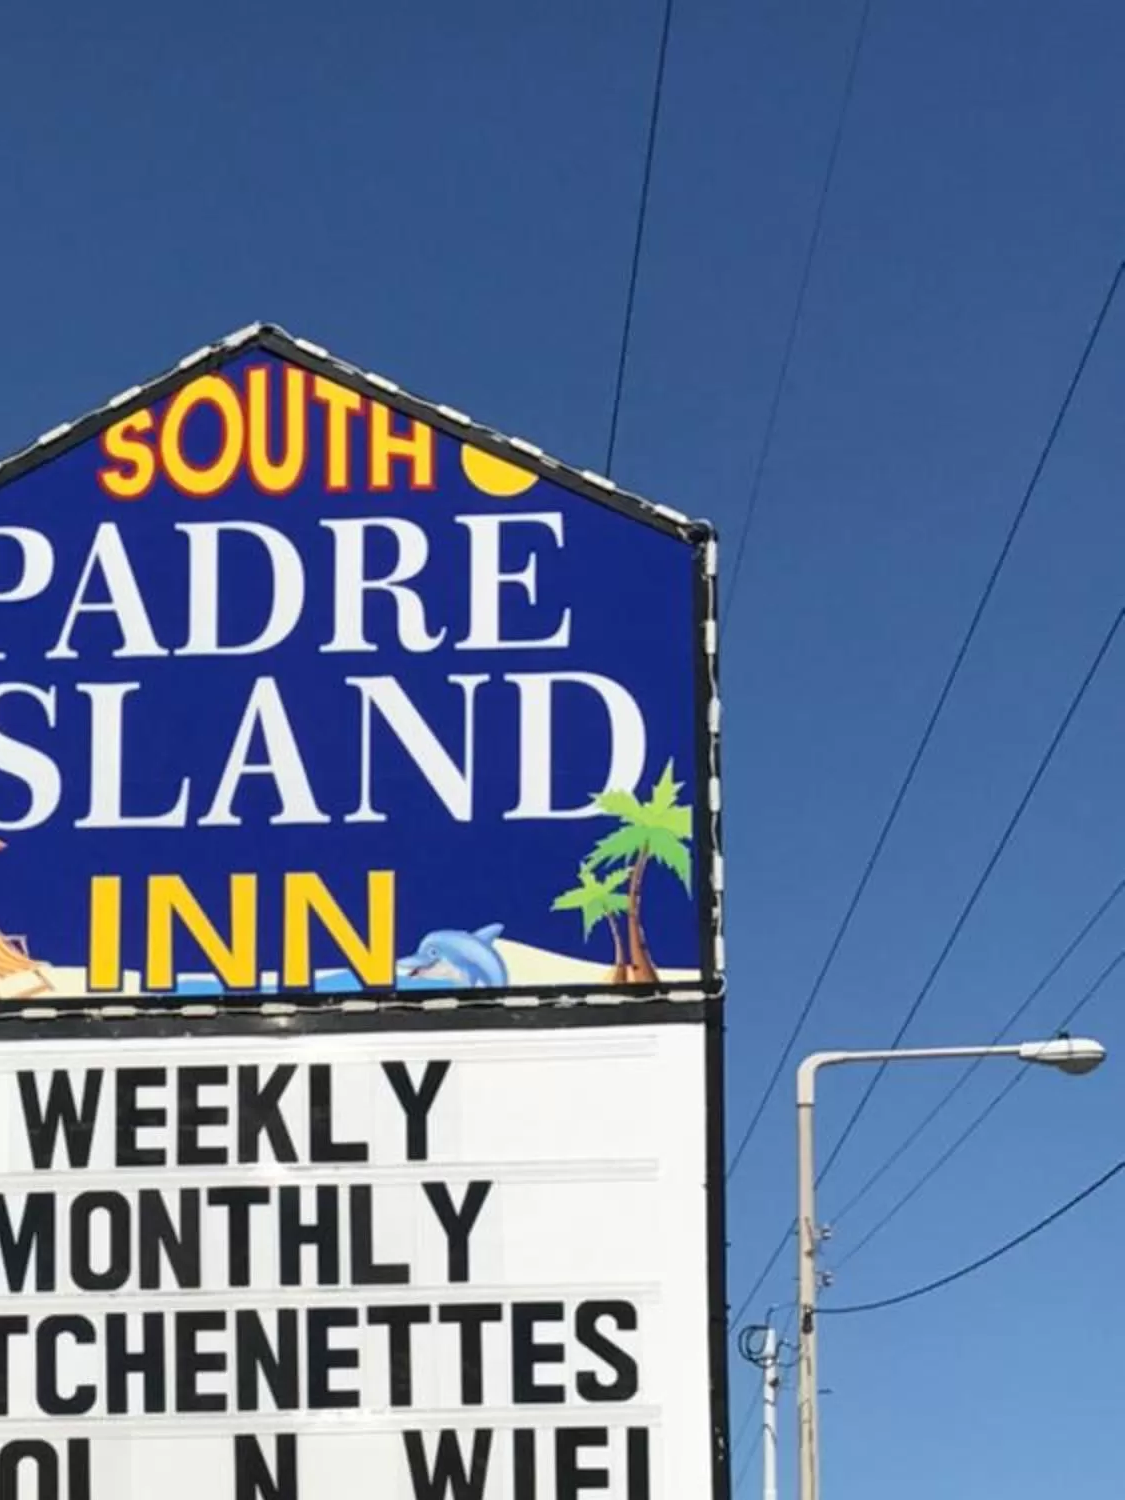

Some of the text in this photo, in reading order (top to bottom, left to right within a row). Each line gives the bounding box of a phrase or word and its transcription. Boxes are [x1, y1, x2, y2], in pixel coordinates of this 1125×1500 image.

[99, 365, 435, 499] SOUTH
[88, 870, 396, 992] INN
[17, 1060, 452, 1169] WEEKLY
